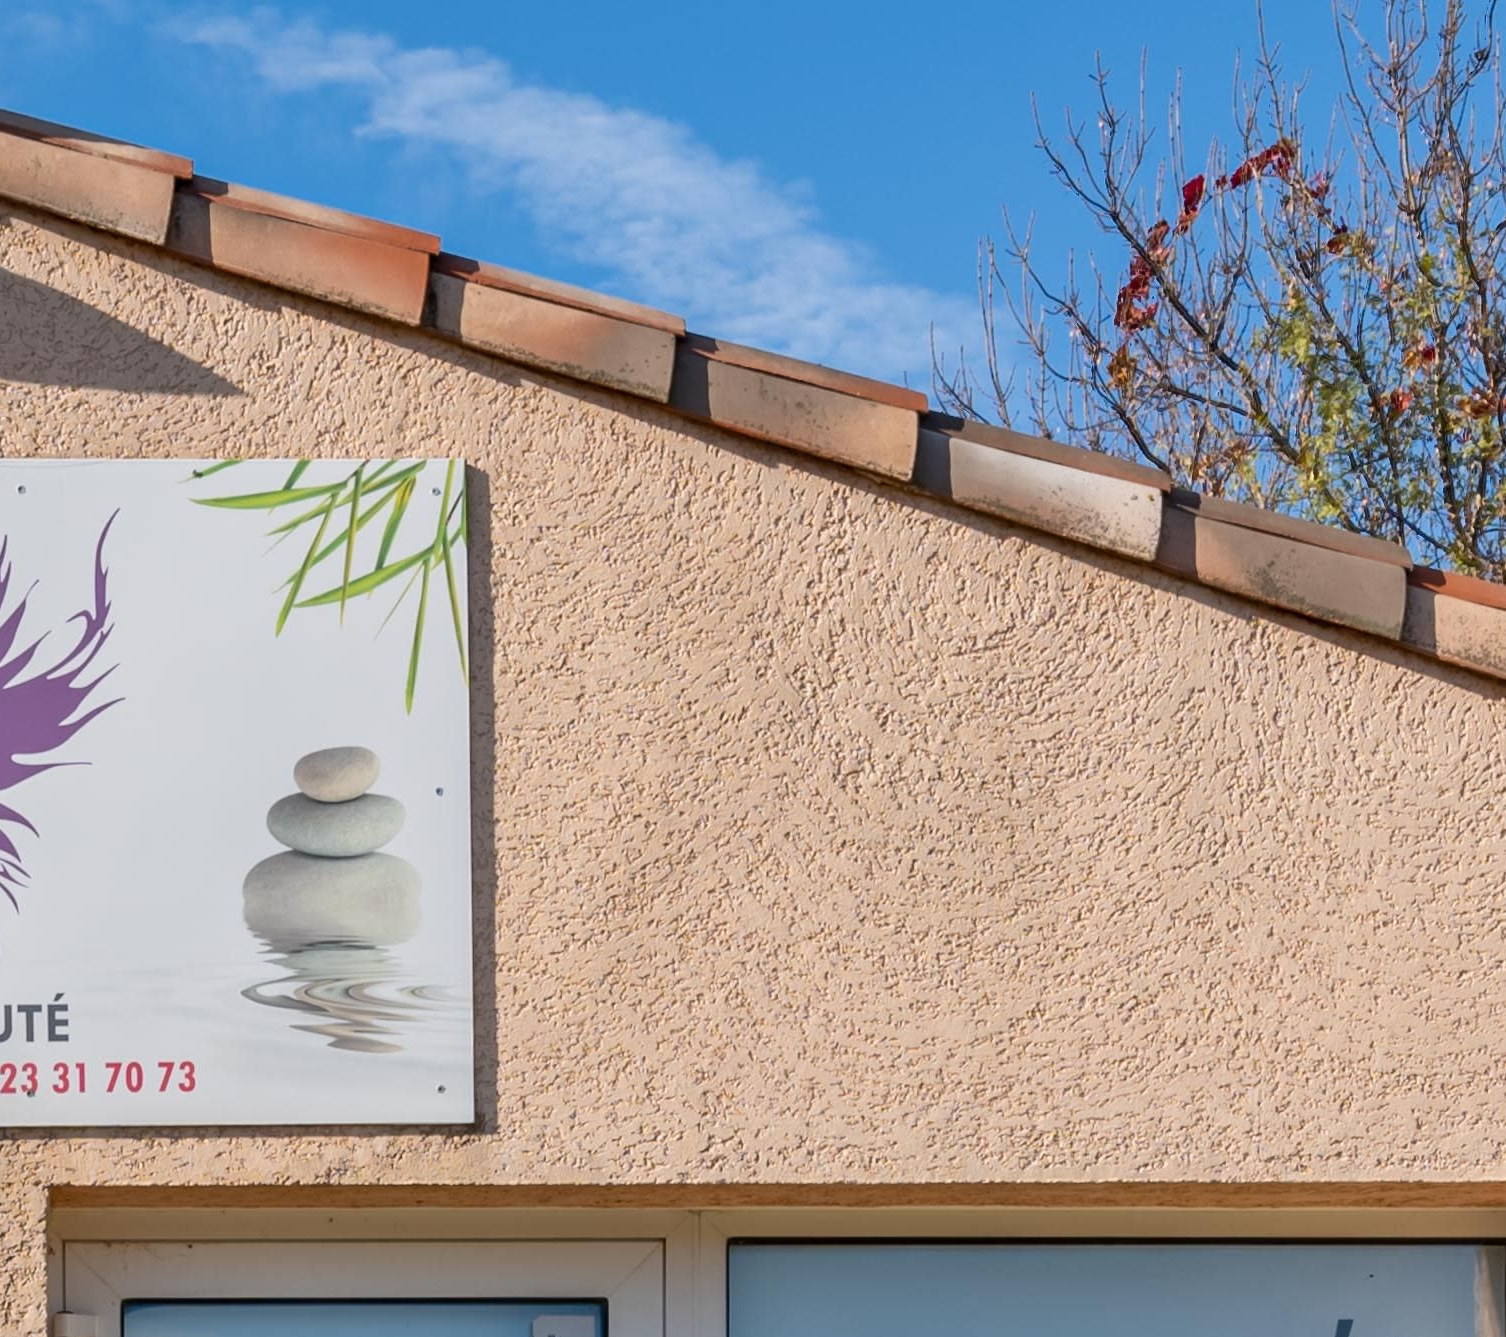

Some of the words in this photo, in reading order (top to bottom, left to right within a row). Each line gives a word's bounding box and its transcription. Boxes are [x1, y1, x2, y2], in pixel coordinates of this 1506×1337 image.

[0, 1062, 39, 1095] 23
[52, 1061, 87, 1094] 31
[105, 1061, 144, 1093] 70
[157, 1060, 197, 1093] 73
